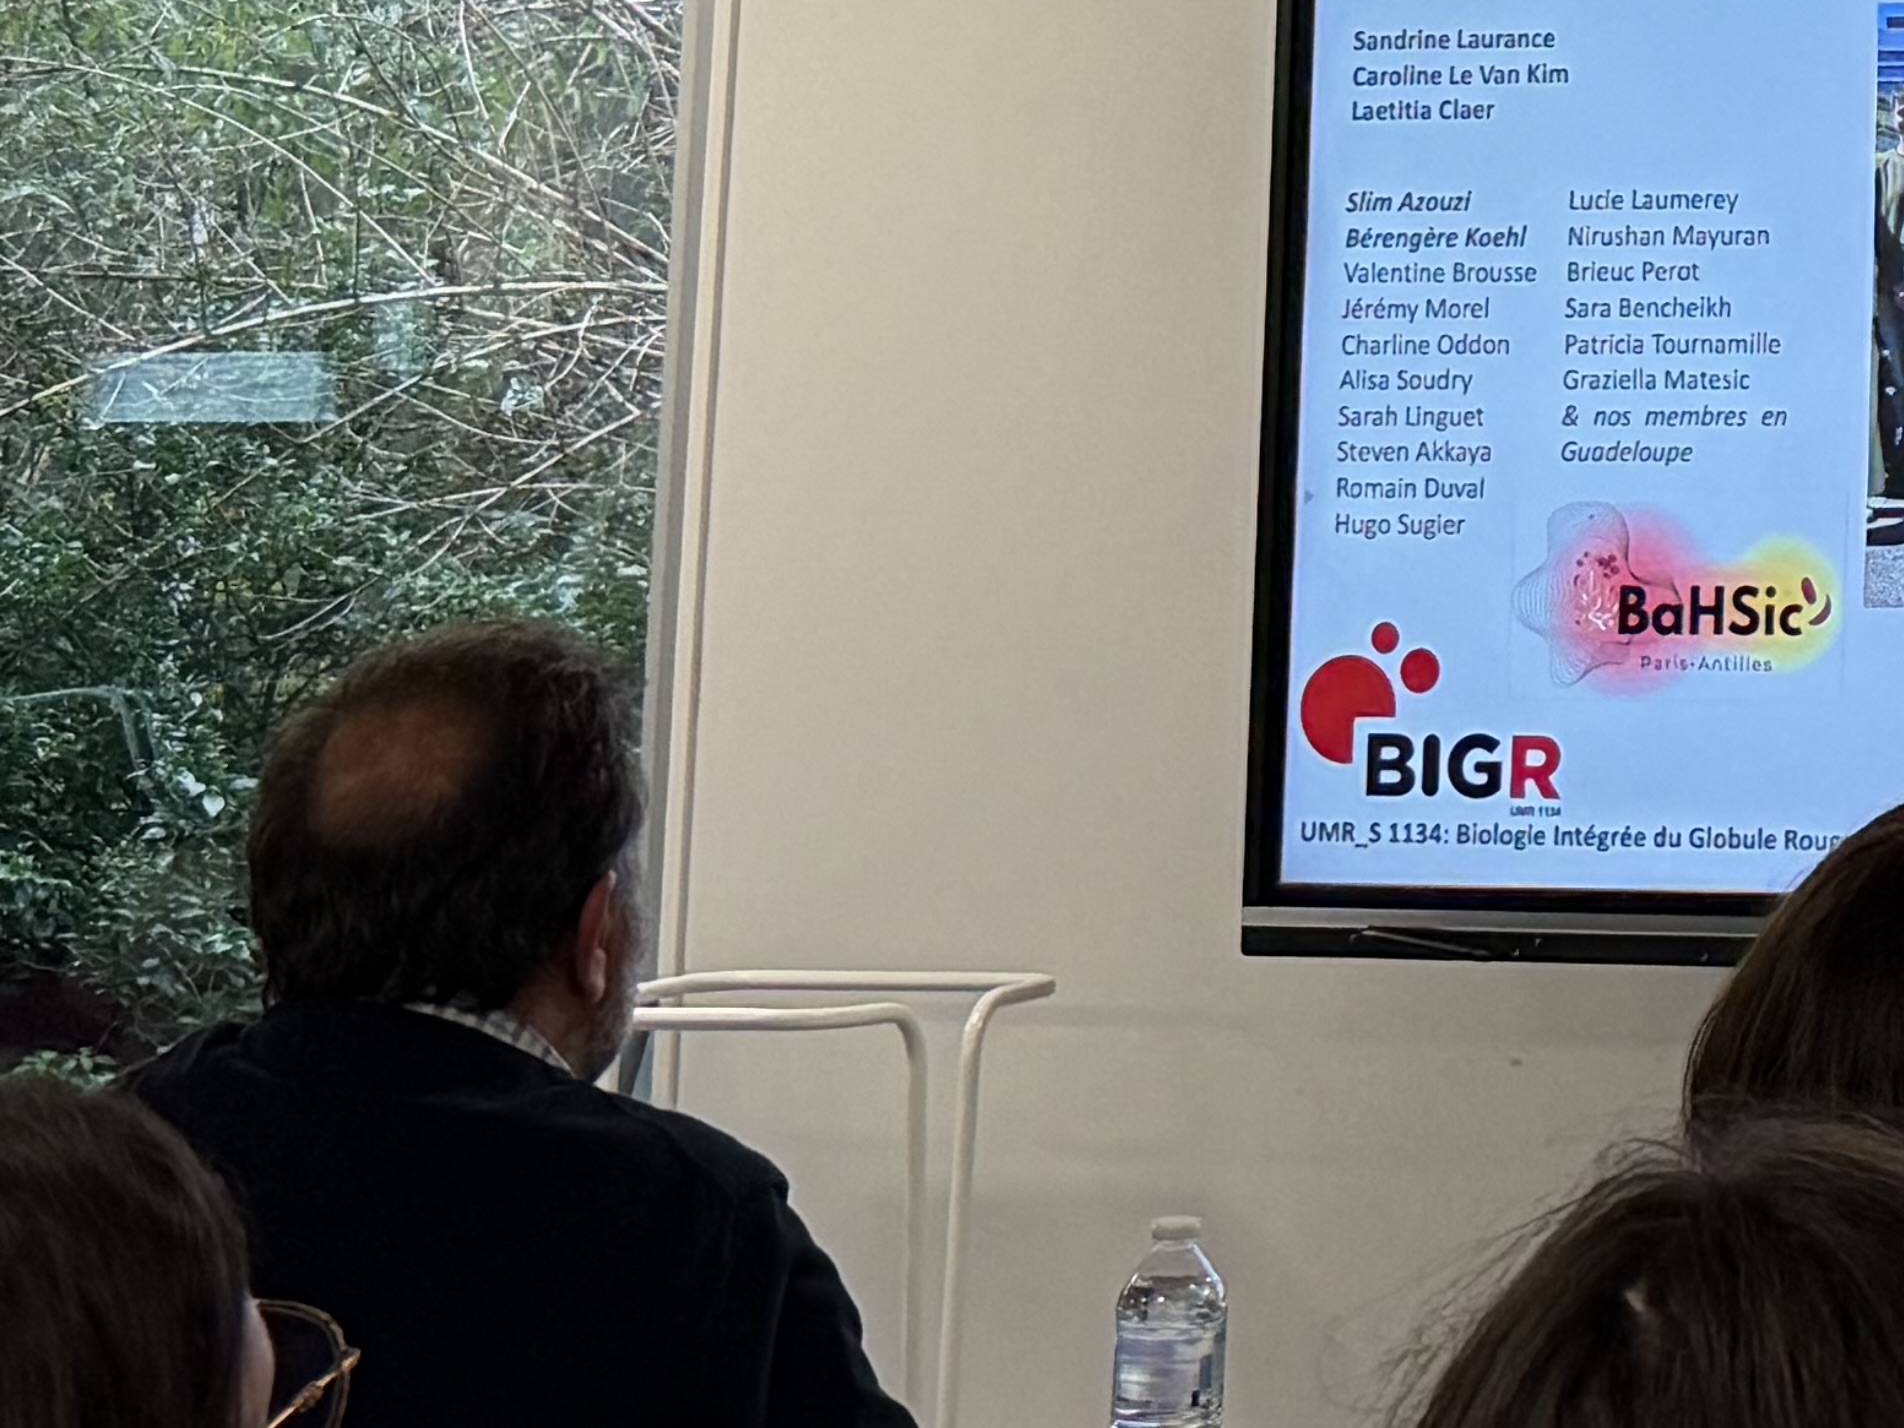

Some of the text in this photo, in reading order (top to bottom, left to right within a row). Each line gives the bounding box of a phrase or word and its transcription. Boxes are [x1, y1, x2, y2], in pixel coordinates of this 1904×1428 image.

[1352, 28, 1556, 52] Sandrine Laurance
[1352, 62, 1569, 87] Caroline Le Van Kim
[1351, 98, 1496, 122] Laetitia Claer
[1345, 190, 1473, 213] Slim Azouzi
[1568, 188, 1739, 215] Lucie Laumerey
[1345, 224, 1528, 254] Bérengère Koehl
[1567, 224, 1770, 251] Nirushan Mayuran
[1343, 261, 1538, 284] Valentine Brousse
[1567, 260, 1700, 283] Brieuc Perot
[1341, 296, 1490, 324] Jérémy Morel
[1564, 295, 1732, 319] Sara Bencheikh
[1341, 332, 1510, 356] Charline Oddon
[1564, 331, 1782, 356] Patricia Tournamille
[1339, 367, 1473, 396] Alisa Soudry
[1562, 367, 1750, 391] Graziella Matesic
[1337, 404, 1485, 433] Sarah Linguet
[1561, 404, 1788, 428] & nos membres en
[1336, 439, 1492, 467] Steven Akkaya
[1560, 439, 1694, 467] Guadeloupe
[1336, 476, 1485, 500] Romain Duval
[1334, 512, 1466, 541] Hugo Sugier
[1617, 584, 1803, 637] BaHSic
[1365, 733, 1561, 799] BIGR
[1300, 820, 1382, 849] UMR_S
[1388, 822, 1449, 845] 1134:
[1456, 821, 1546, 851] Biologie
[1553, 823, 1647, 853] Intégrée
[1653, 825, 1682, 849] du
[1688, 825, 1778, 850] Globule
